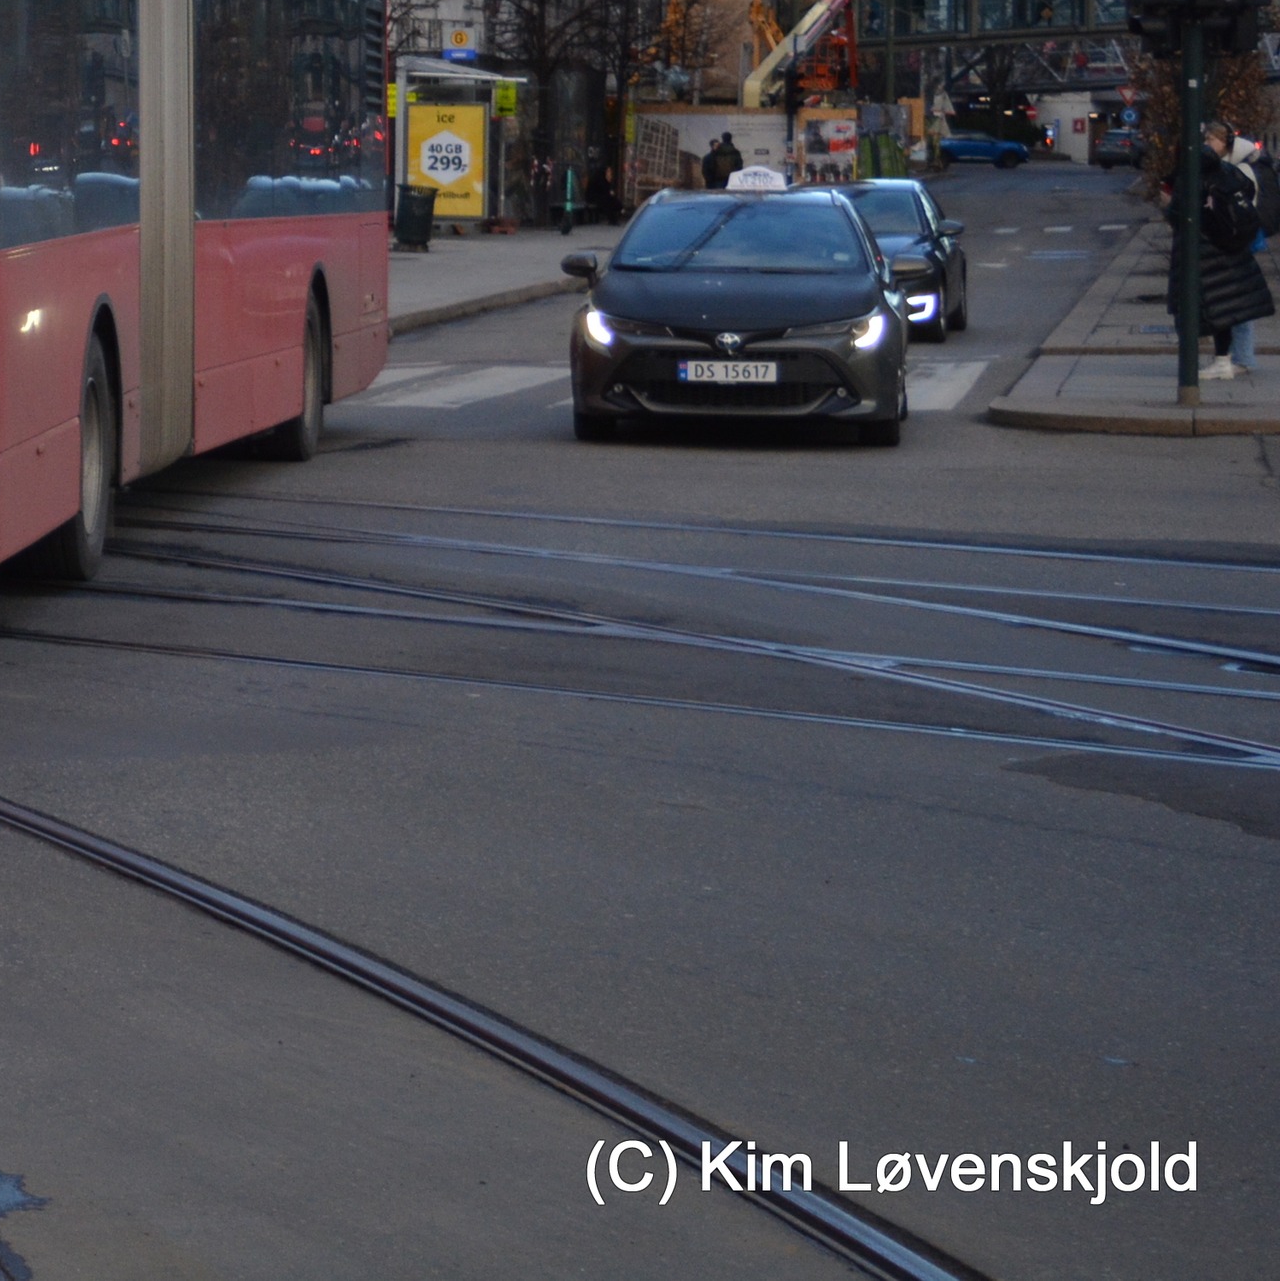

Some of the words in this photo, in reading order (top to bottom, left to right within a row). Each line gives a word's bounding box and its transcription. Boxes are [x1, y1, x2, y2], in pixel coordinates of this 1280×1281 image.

[437, 110, 455, 123] ice
[428, 144, 442, 154] 40
[445, 144, 462, 154] GB
[694, 364, 715, 379] DS
[723, 364, 769, 379] 15617
